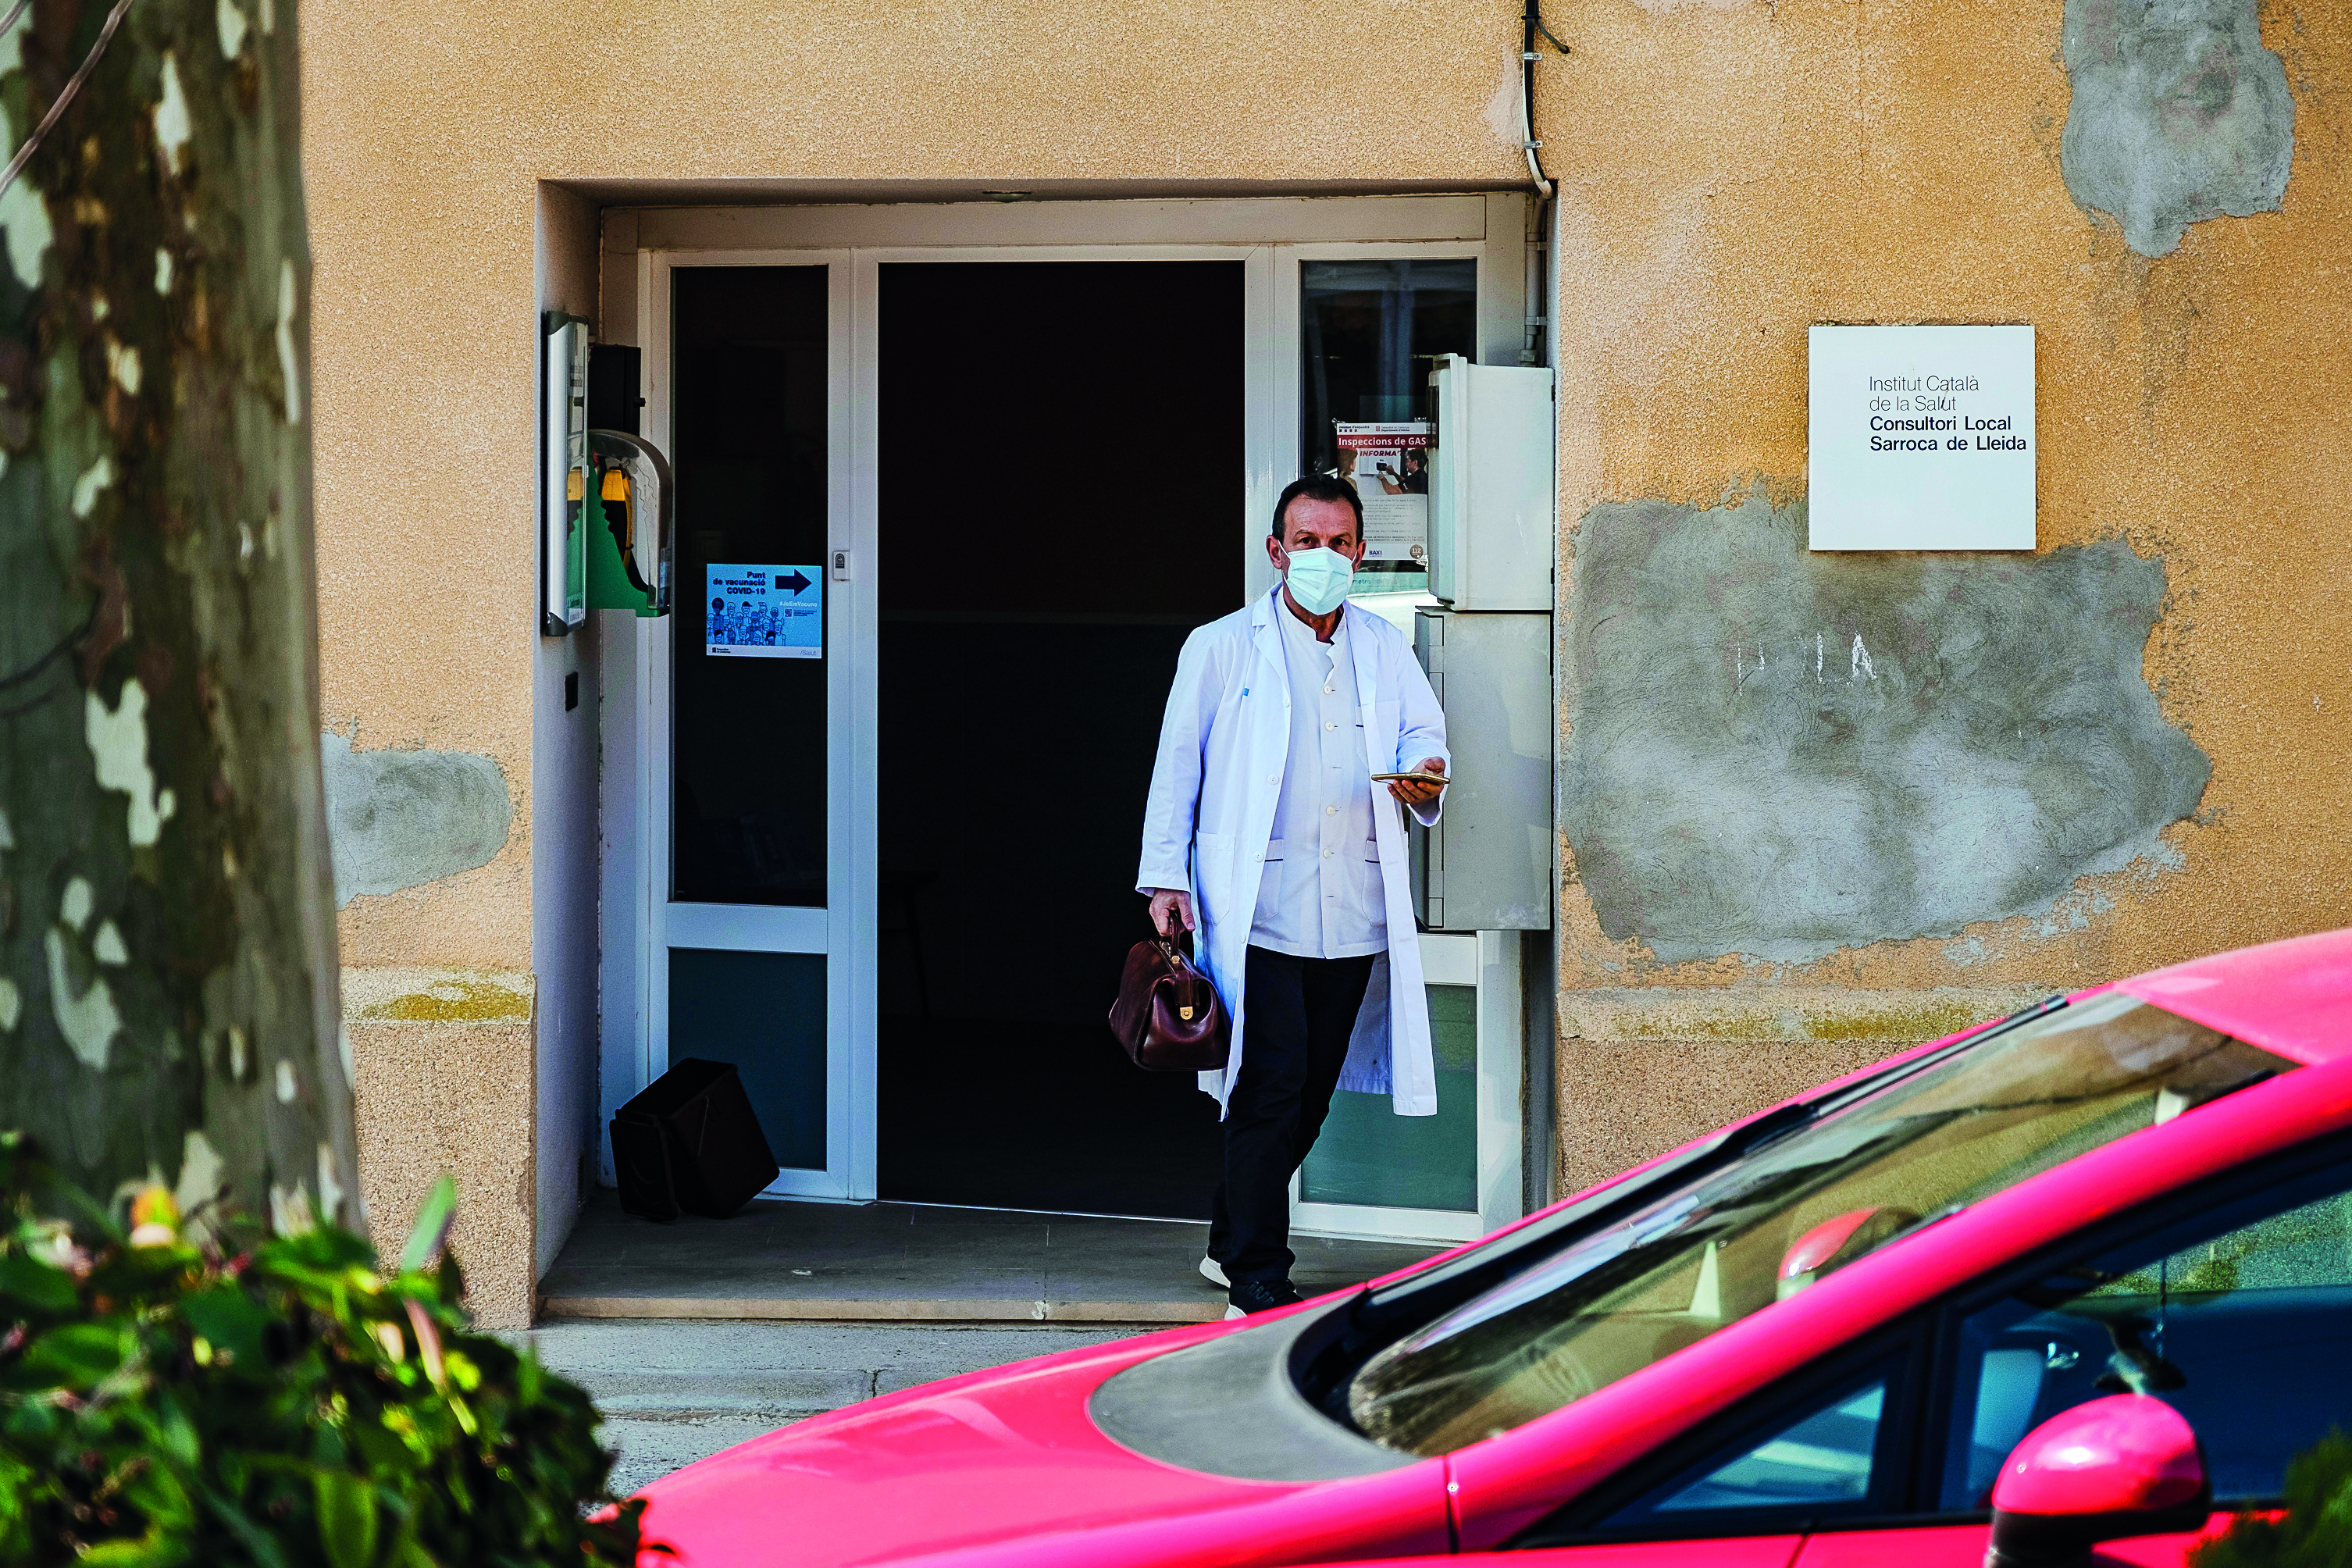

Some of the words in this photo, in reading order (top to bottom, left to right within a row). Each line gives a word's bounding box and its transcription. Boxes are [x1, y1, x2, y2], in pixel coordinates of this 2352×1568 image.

[1869, 376, 1922, 392] Institut
[1926, 375, 1980, 392] Català
[1869, 395, 1891, 412] de
[1897, 395, 1910, 412] la
[1915, 395, 1957, 412] Salut
[1870, 415, 1957, 431] Consultori
[1965, 415, 2012, 431] Local
[1338, 437, 1392, 447] Inspeccions
[1408, 437, 1427, 446] GAS
[1870, 435, 1938, 451] Sarroca
[1946, 435, 1969, 451] de
[1976, 435, 2027, 451] Lleida
[725, 578, 766, 586] vacunació
[726, 586, 766, 595] COVID-19
